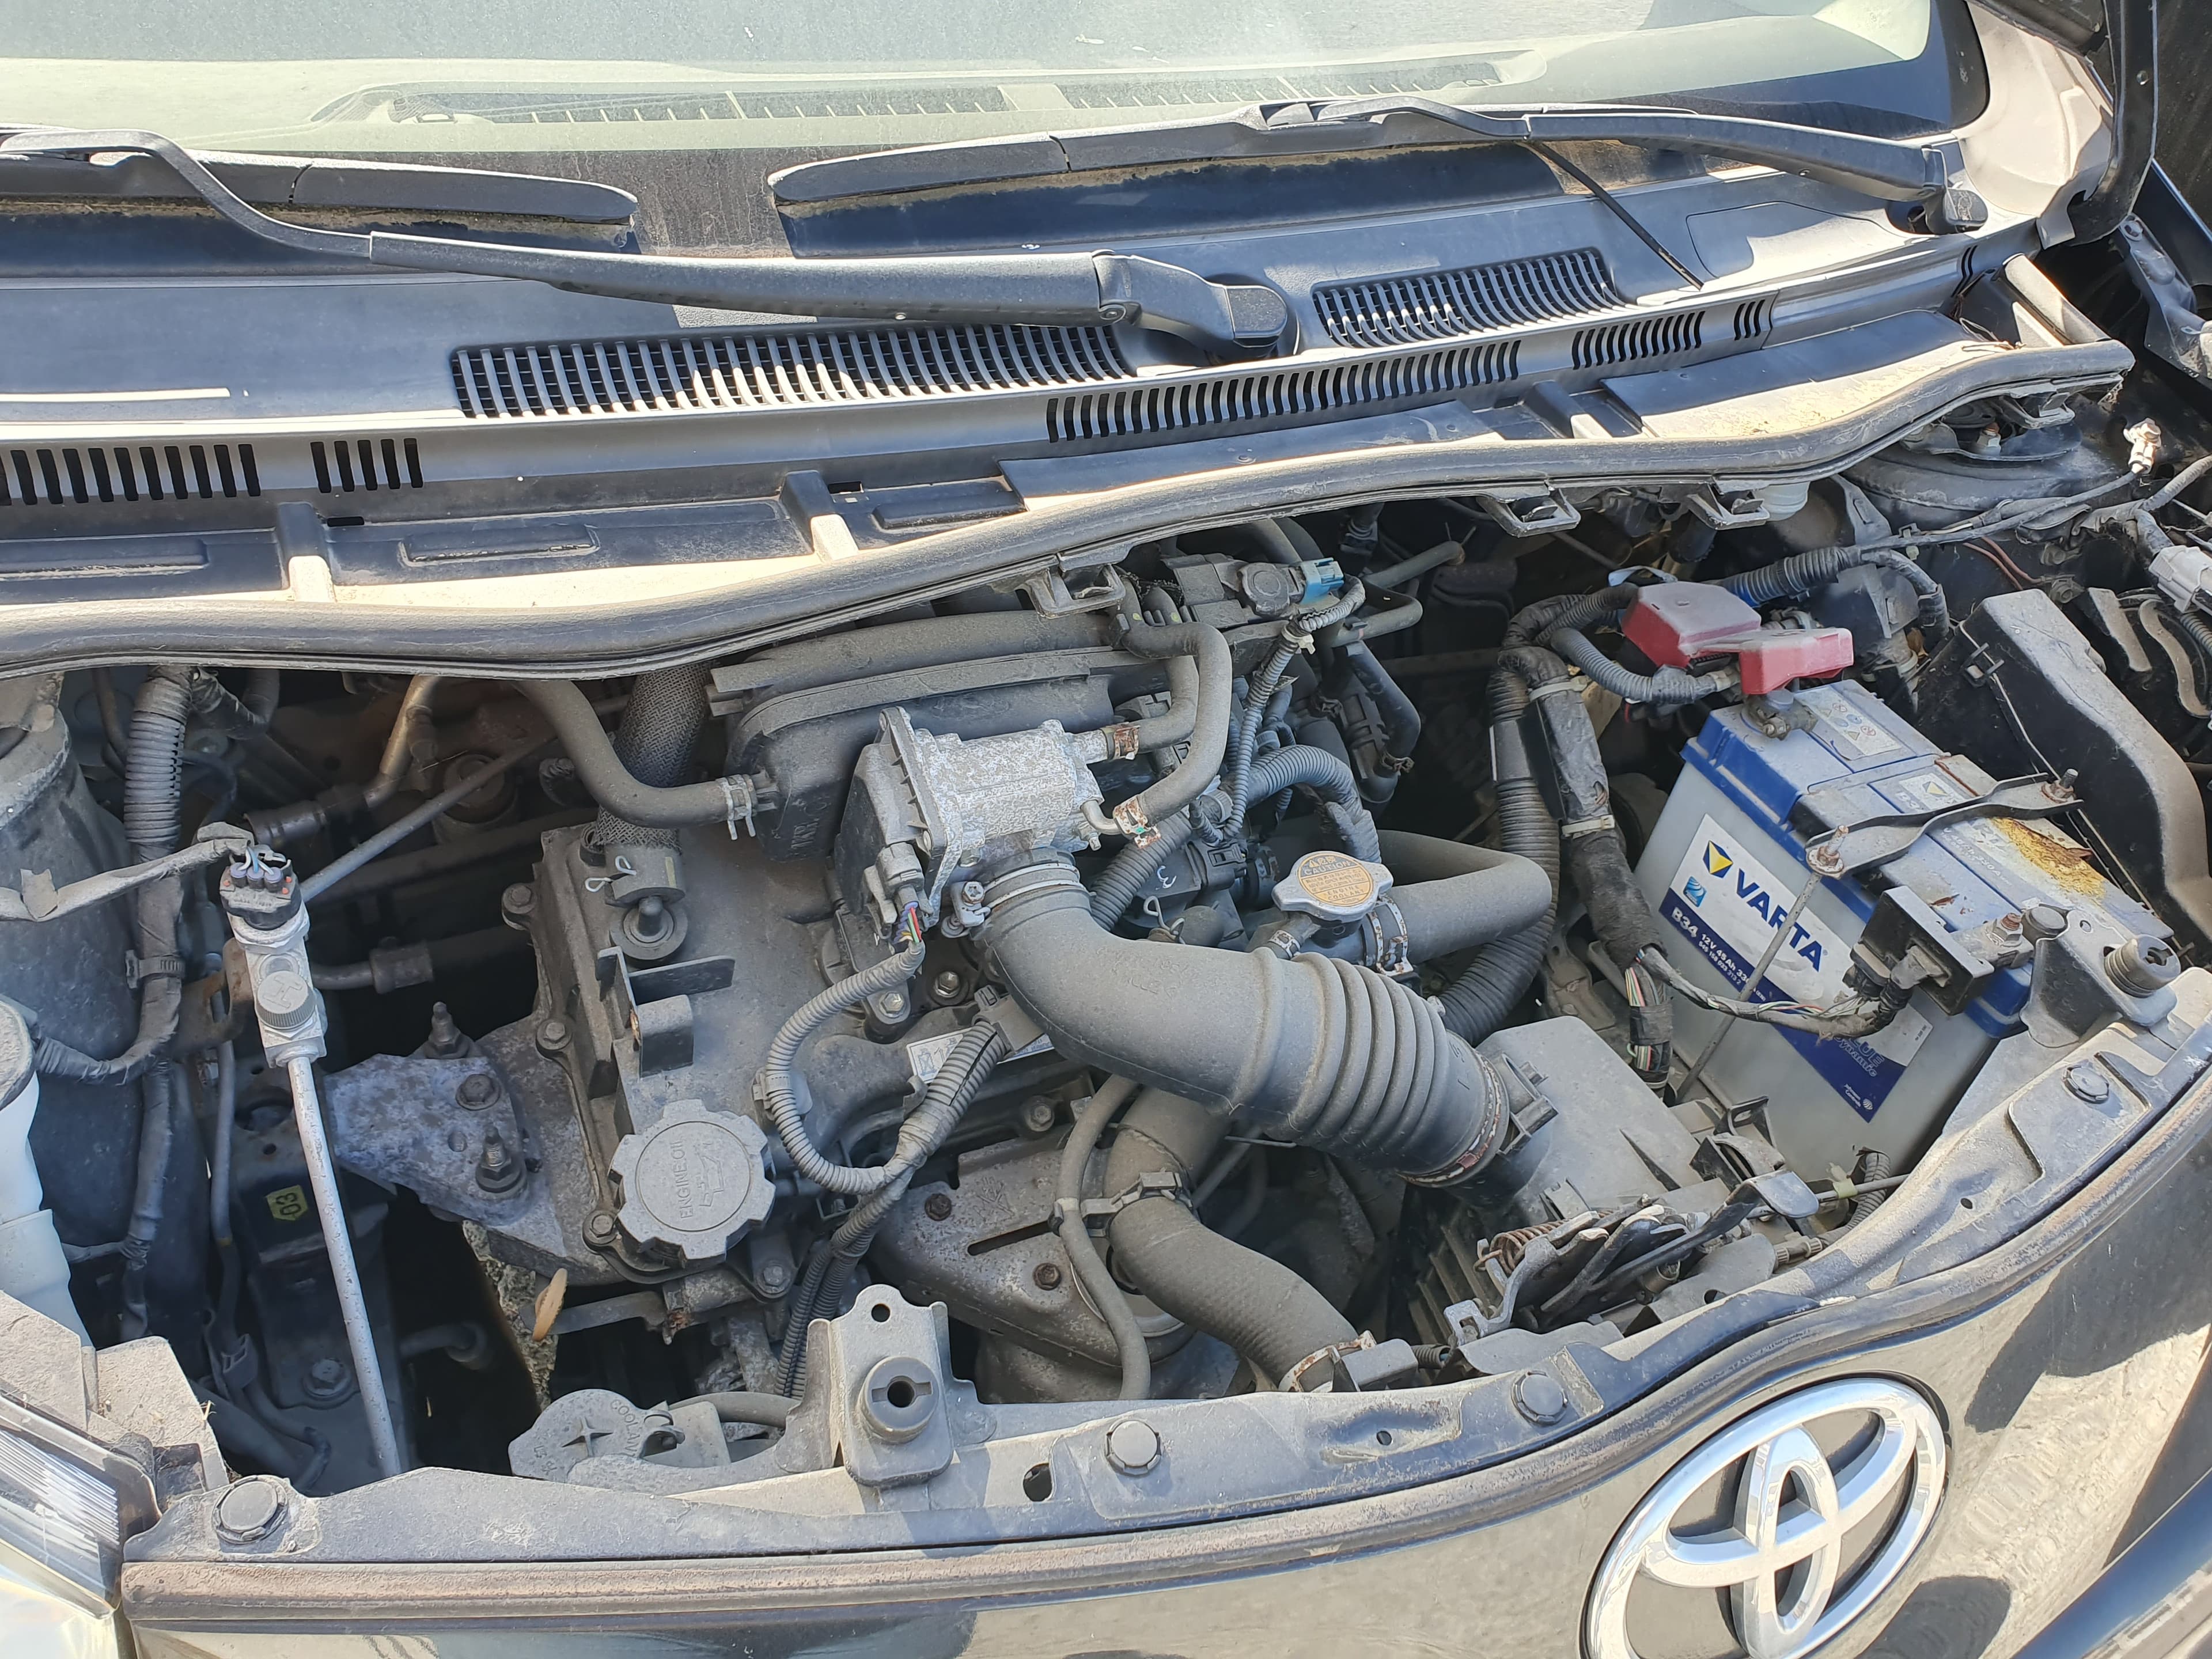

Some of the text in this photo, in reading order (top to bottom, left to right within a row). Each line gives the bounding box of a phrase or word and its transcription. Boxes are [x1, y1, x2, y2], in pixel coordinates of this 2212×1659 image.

[1304, 861, 1350, 875] CAUTION
[1327, 886, 1360, 896] ENGINE
[1327, 889, 1365, 900] COOLANT
[1736, 868, 1825, 972] VARTA
[1672, 907, 1698, 937] B34
[1702, 934, 1717, 949] 12V
[1716, 949, 1736, 971] 45Ah
[1849, 1037, 1885, 1067] LUE
[669, 1141, 694, 1219] ENGINE OIL
[276, 1192, 302, 1215] 03
